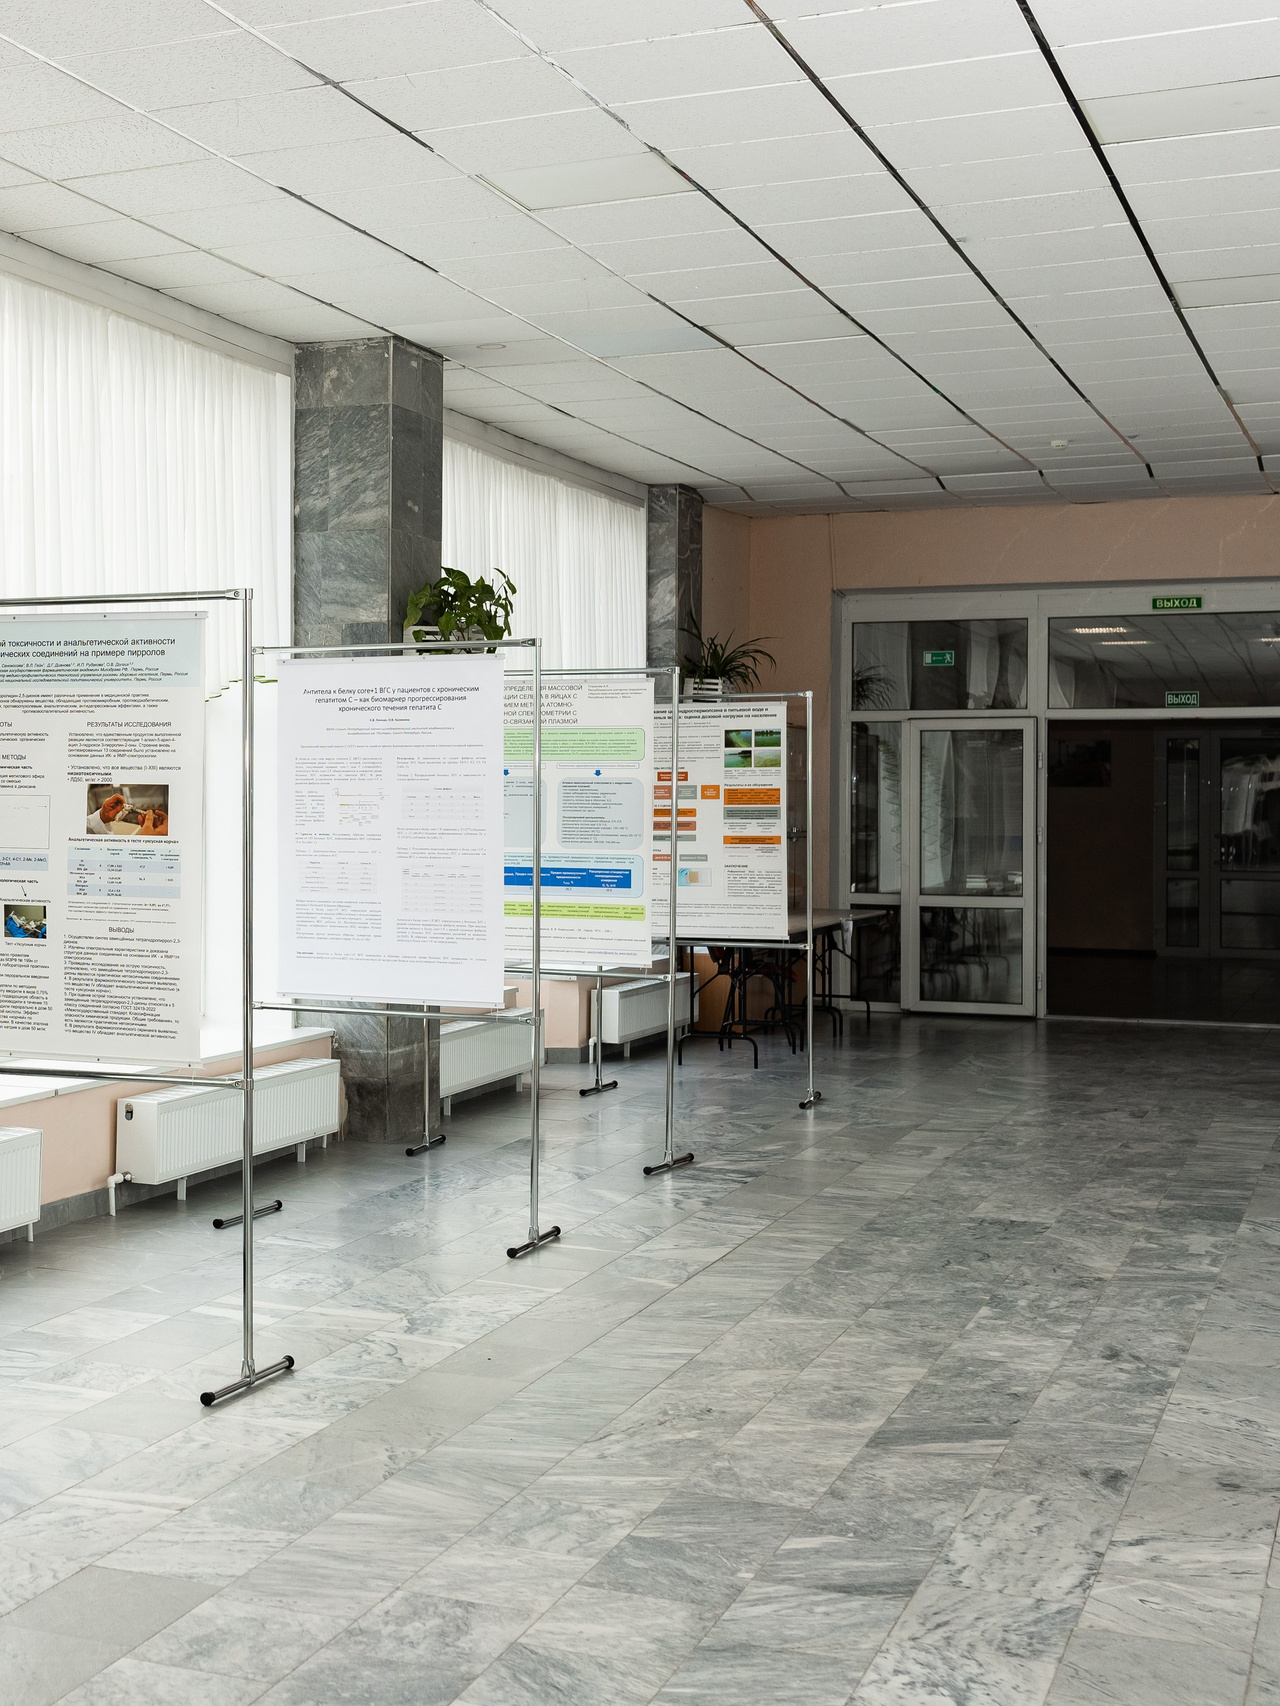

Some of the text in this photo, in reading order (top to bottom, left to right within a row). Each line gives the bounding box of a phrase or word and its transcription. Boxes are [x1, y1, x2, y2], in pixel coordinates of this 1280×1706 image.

[1156, 599, 1197, 608] ВЫХОД
[63, 638, 128, 646] анальгетической
[32, 649, 78, 658] соединений
[91, 650, 126, 658] примере
[128, 650, 165, 658] пирролов
[1167, 694, 1197, 705] ВЫХОД
